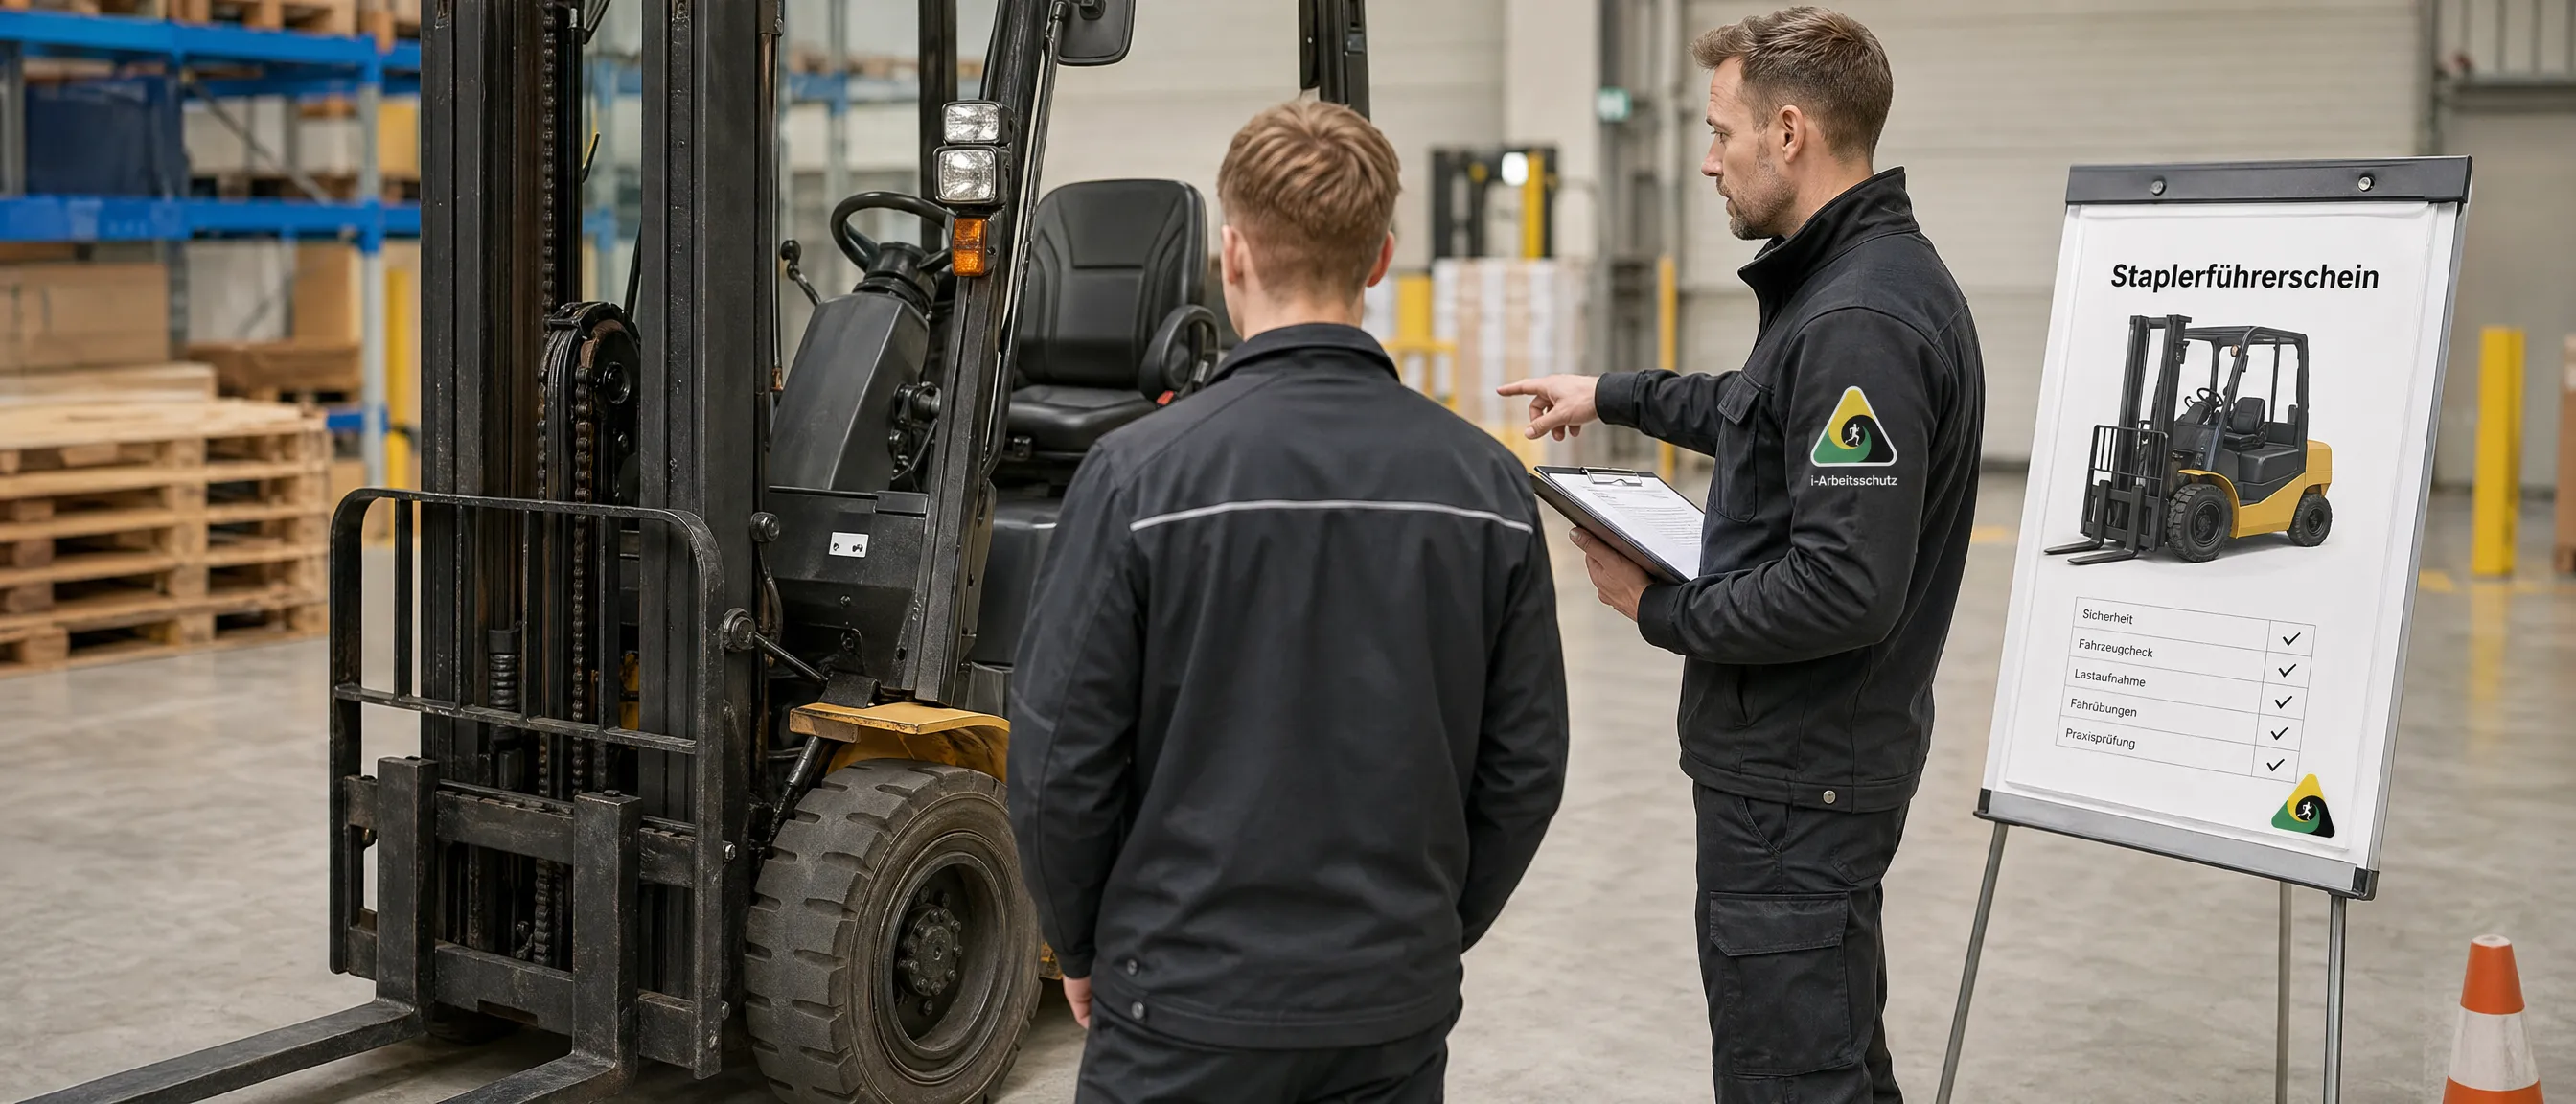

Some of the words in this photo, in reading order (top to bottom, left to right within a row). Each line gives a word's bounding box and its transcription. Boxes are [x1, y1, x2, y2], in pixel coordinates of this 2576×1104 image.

[2110, 263, 2380, 293] Staplerführerschein
[1810, 474, 1898, 487] i-Arbeitsschutz
[2082, 609, 2133, 625] Sicherheit
[2079, 638, 2153, 658] Fahrzeugcheck
[2074, 668, 2146, 688] Lastaufnahme
[2070, 698, 2137, 719] Fahrübungen
[2065, 727, 2136, 750] Praxisprüfung
